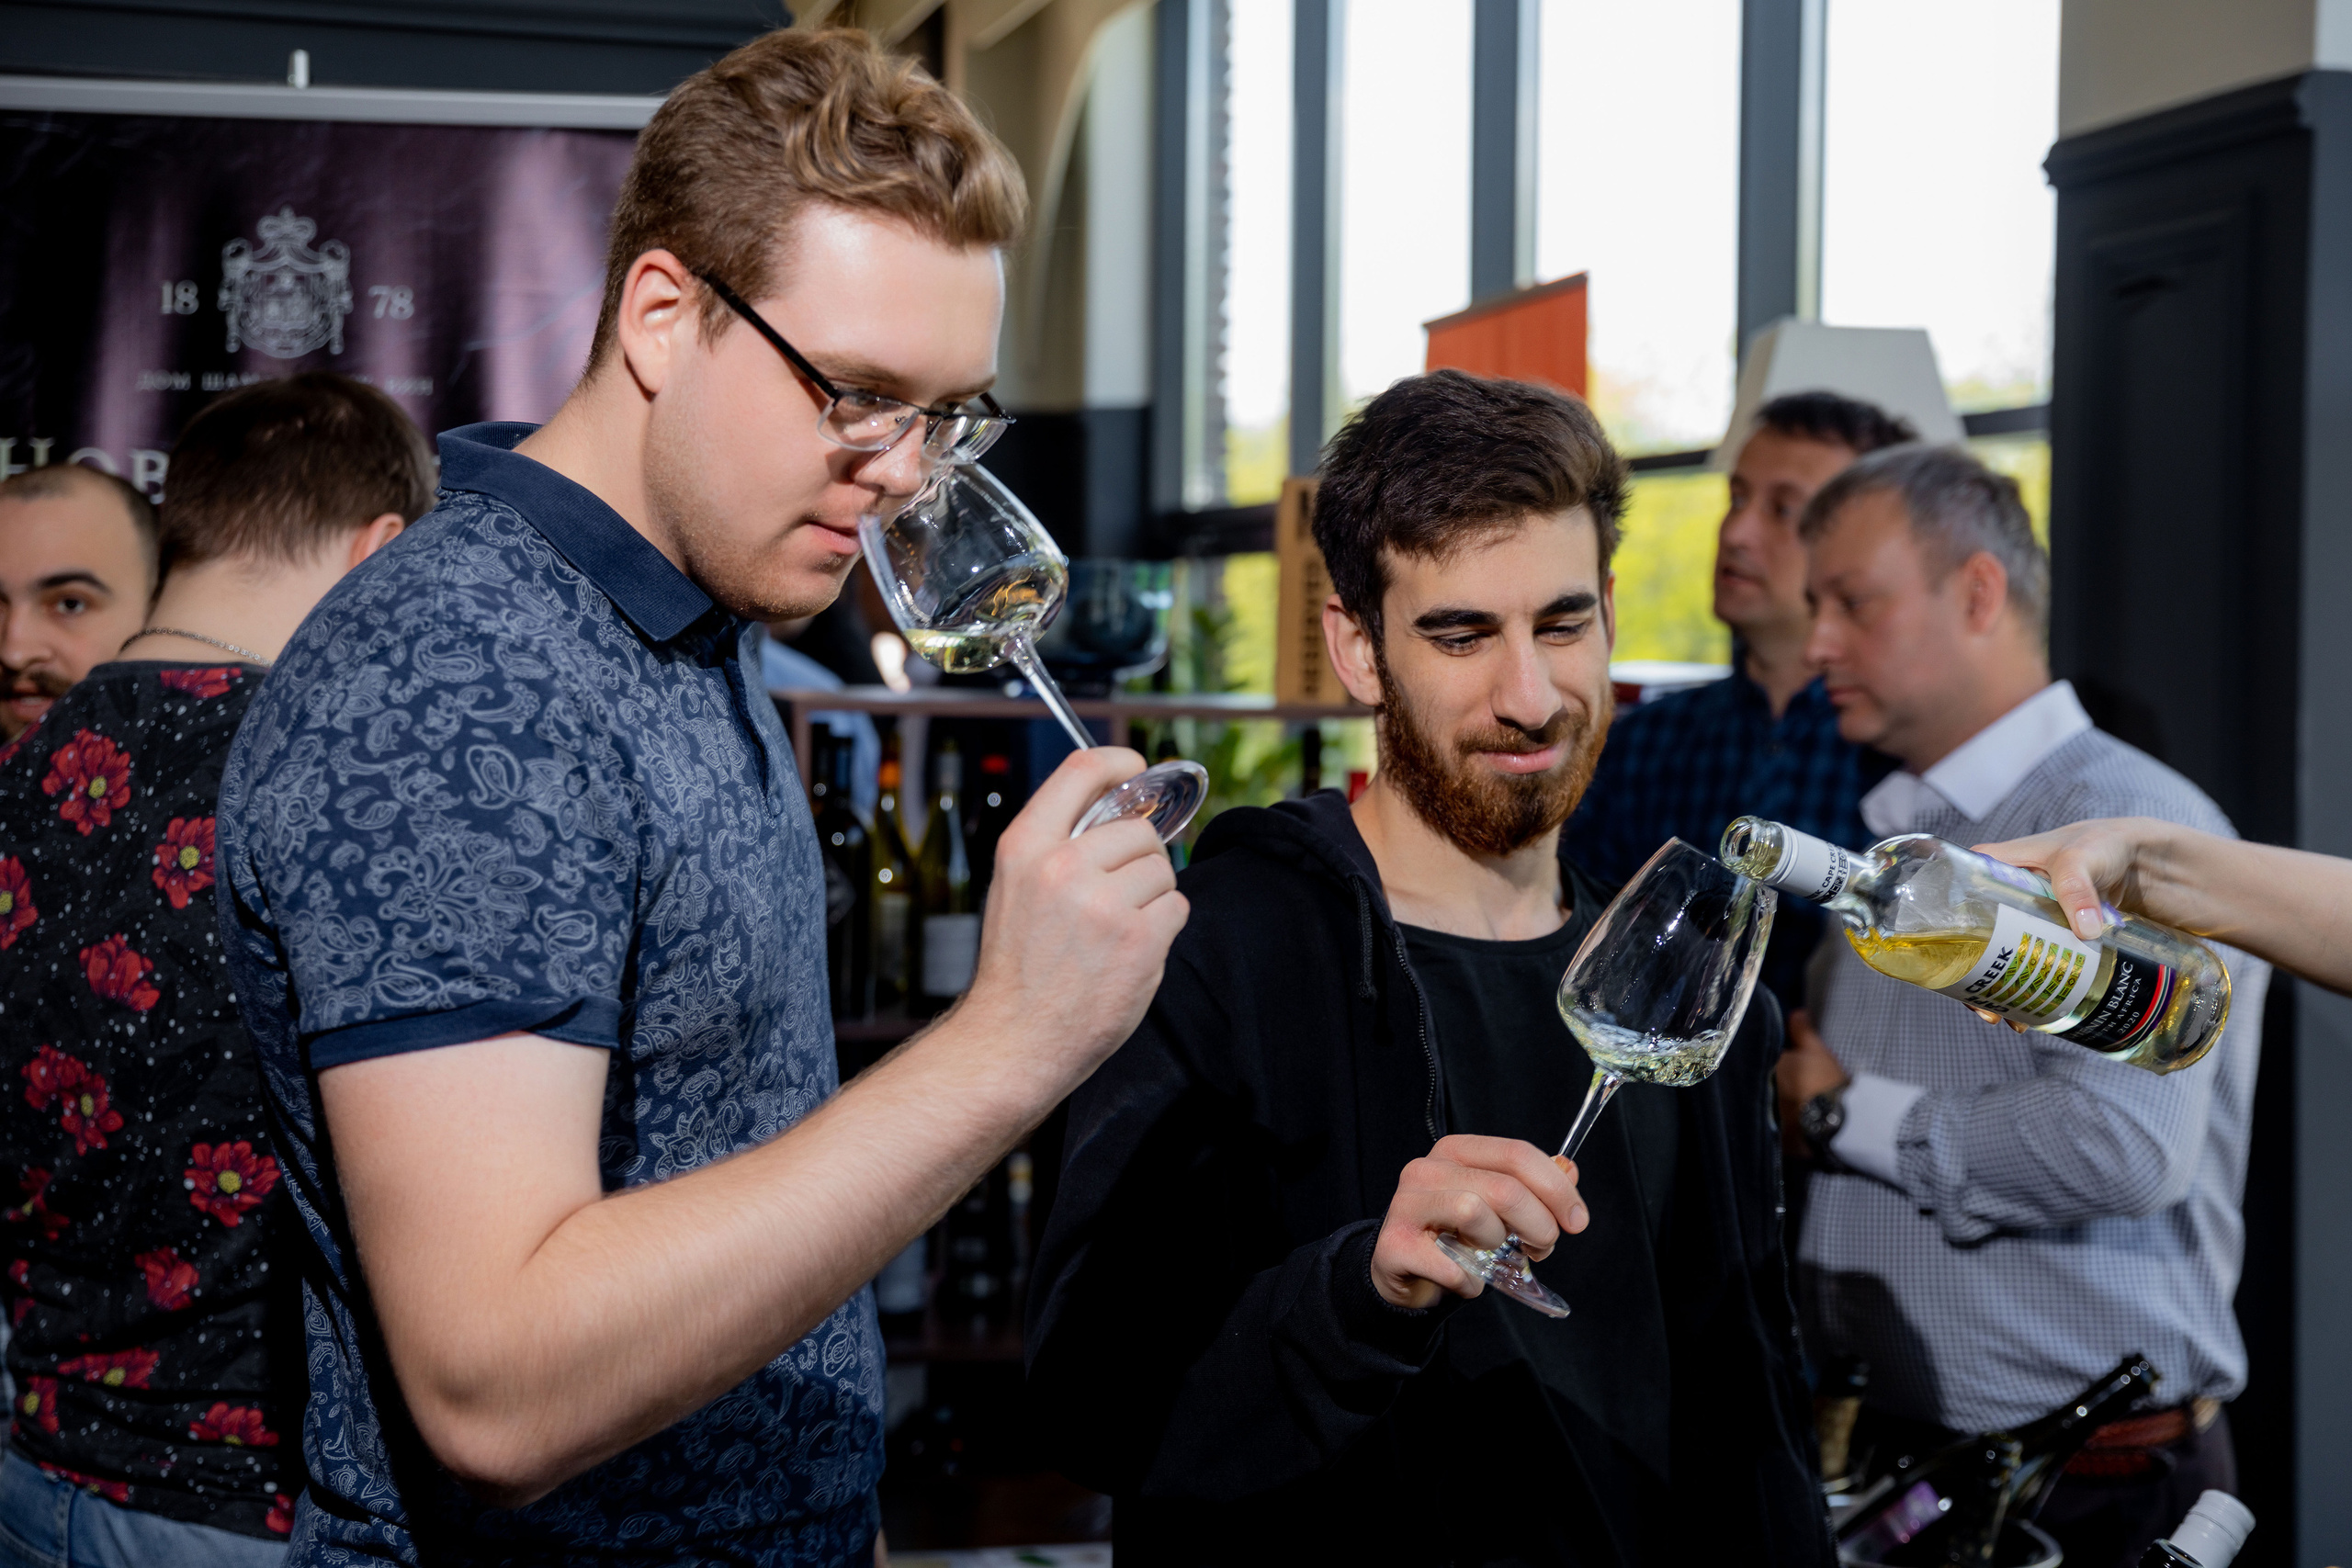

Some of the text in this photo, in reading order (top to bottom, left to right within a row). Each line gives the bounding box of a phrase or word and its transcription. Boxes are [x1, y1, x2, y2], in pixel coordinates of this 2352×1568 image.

[161, 279, 414, 320] 18 78
[1822, 864, 1836, 888] CAPE
[1964, 945, 2014, 993] CREEK
[2105, 961, 2133, 1010] BLANC
[2117, 977, 2142, 1020] AFRICA
[2117, 1011, 2140, 1034] 2020
